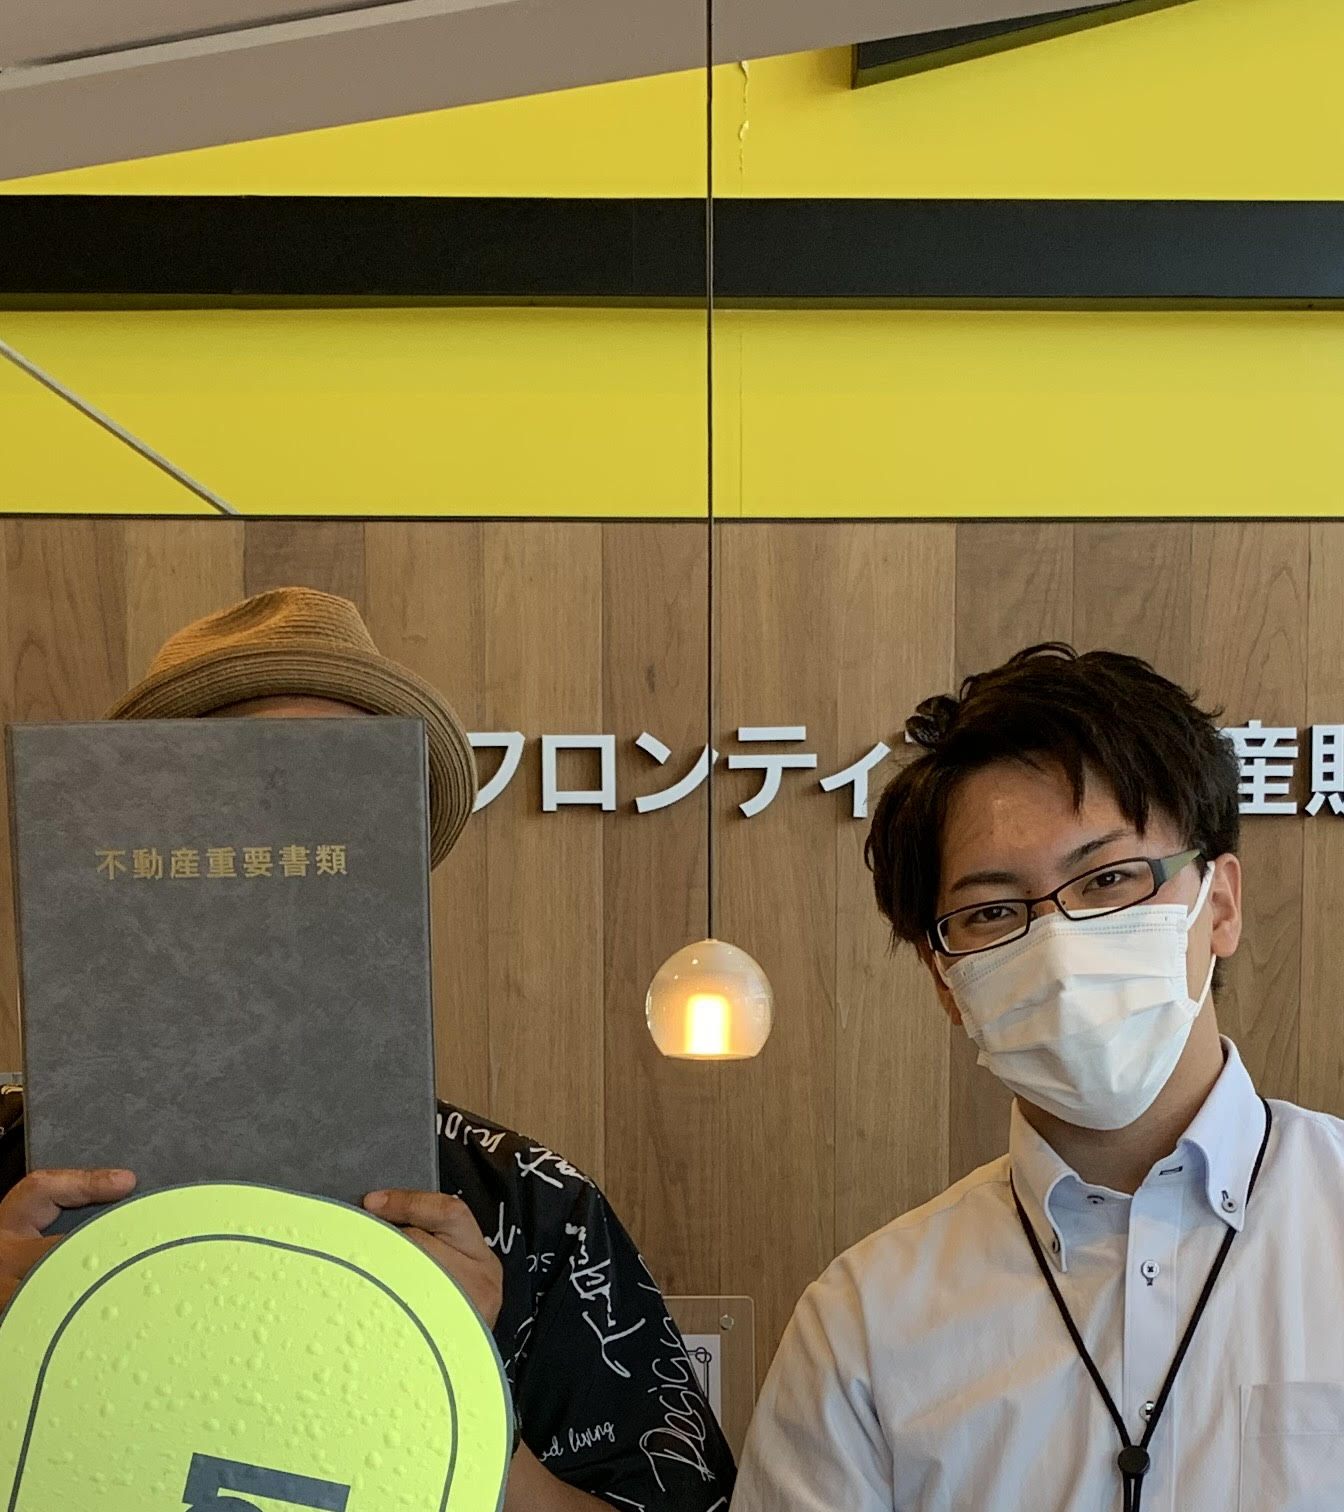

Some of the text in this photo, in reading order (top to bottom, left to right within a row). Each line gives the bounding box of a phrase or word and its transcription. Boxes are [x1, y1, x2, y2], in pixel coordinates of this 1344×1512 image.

[95, 845, 348, 880] 不動産重要書類
